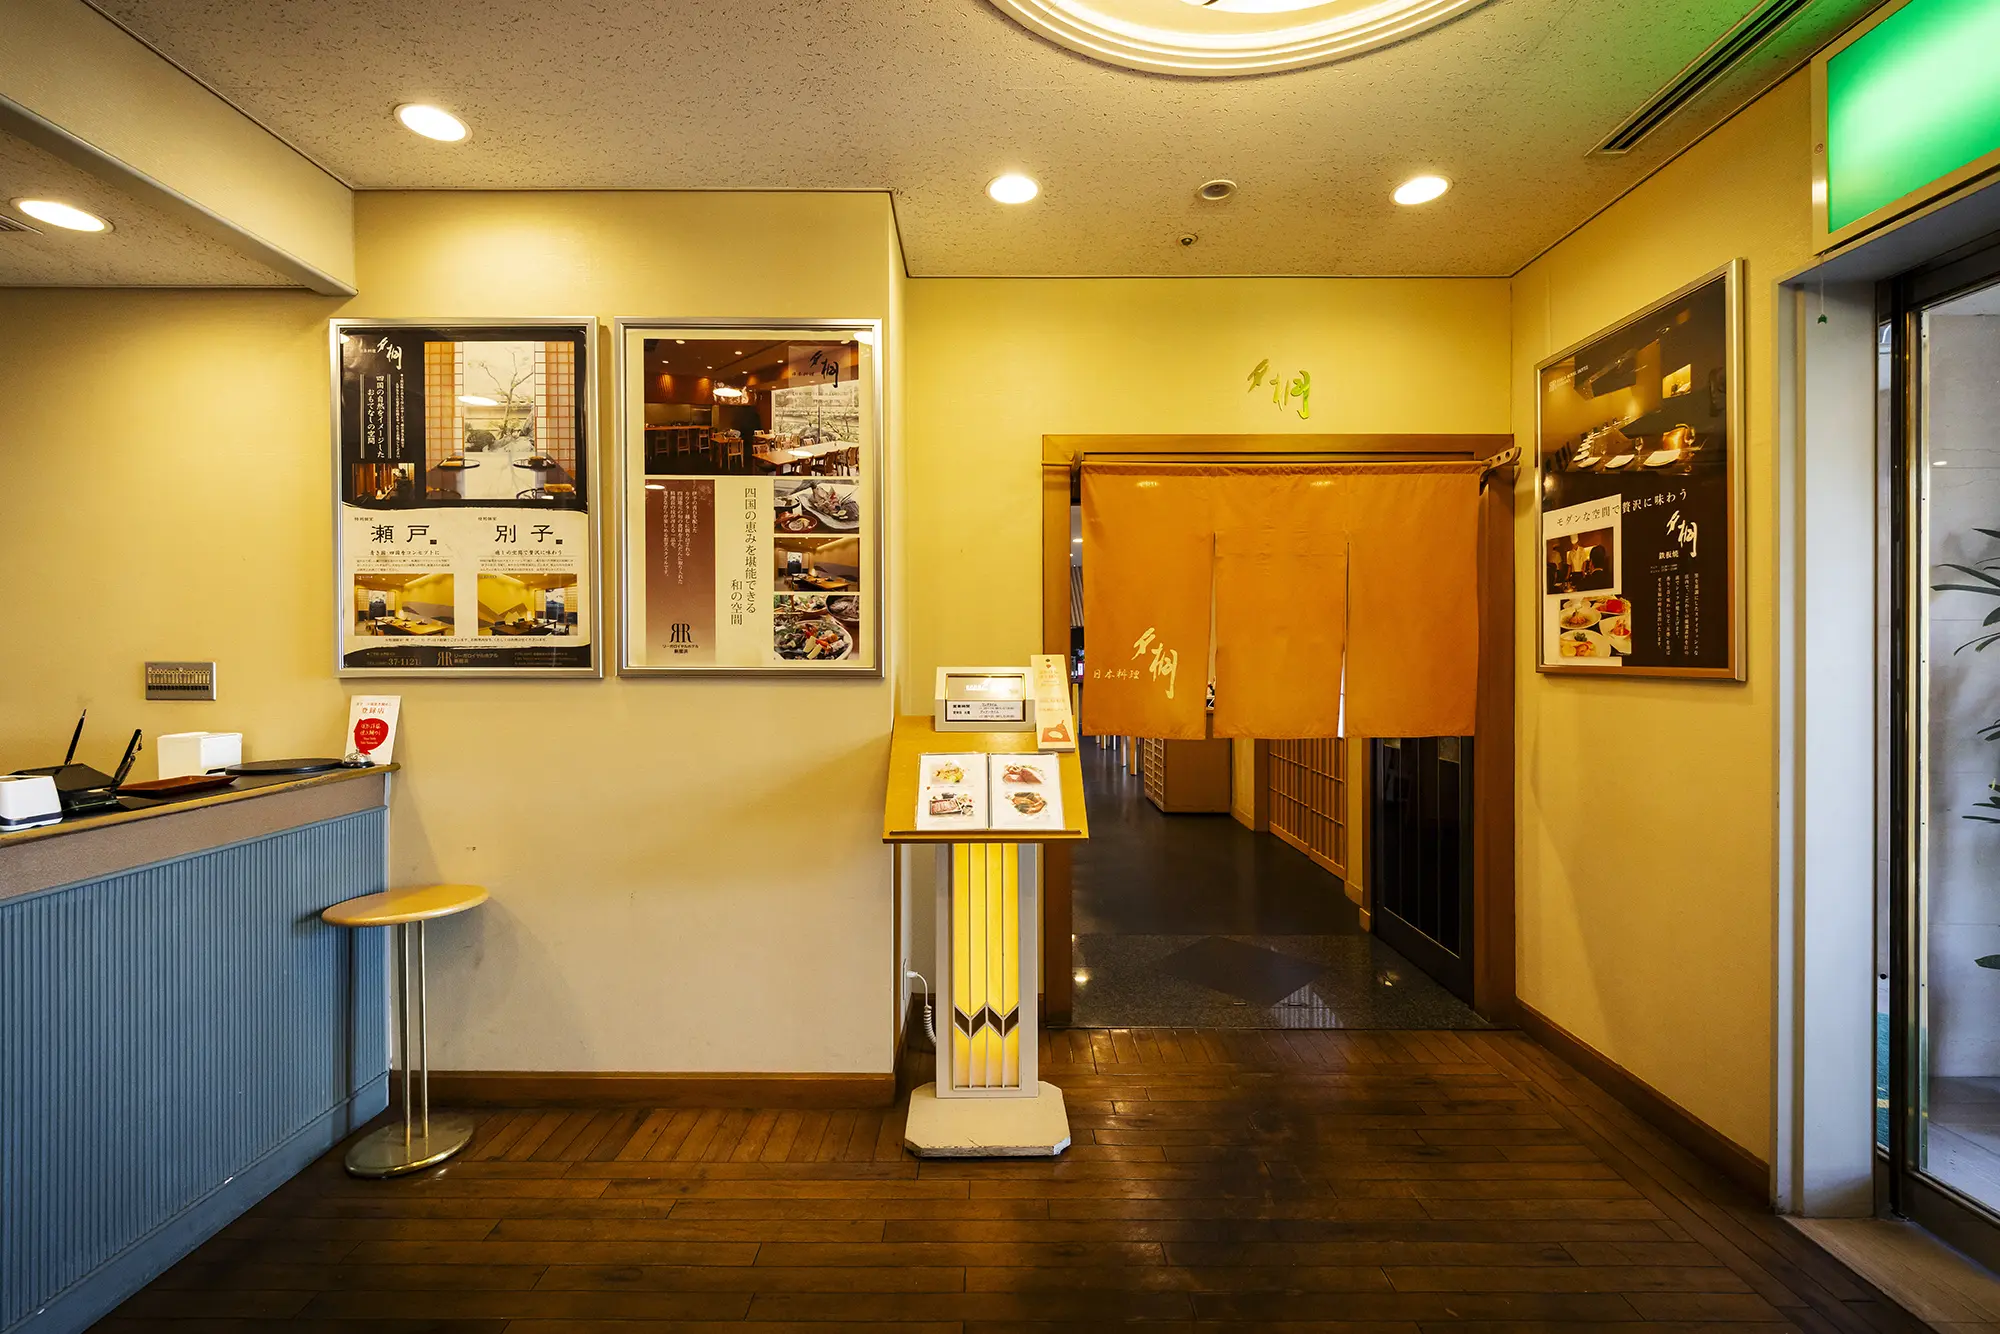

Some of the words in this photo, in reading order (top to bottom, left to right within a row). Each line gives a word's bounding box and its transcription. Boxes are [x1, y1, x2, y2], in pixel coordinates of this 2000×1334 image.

[367, 388, 376, 445] おもてなしの空間
[1556, 488, 1687, 527] モダンな空間で贅沢に味わう
[371, 524, 430, 544] 瀬戸
[494, 524, 554, 543] 別子
[744, 487, 757, 614] 四国の恵みを堪能できる
[730, 578, 743, 626] 和の空間
[1093, 668, 1140, 681] 日本料理
